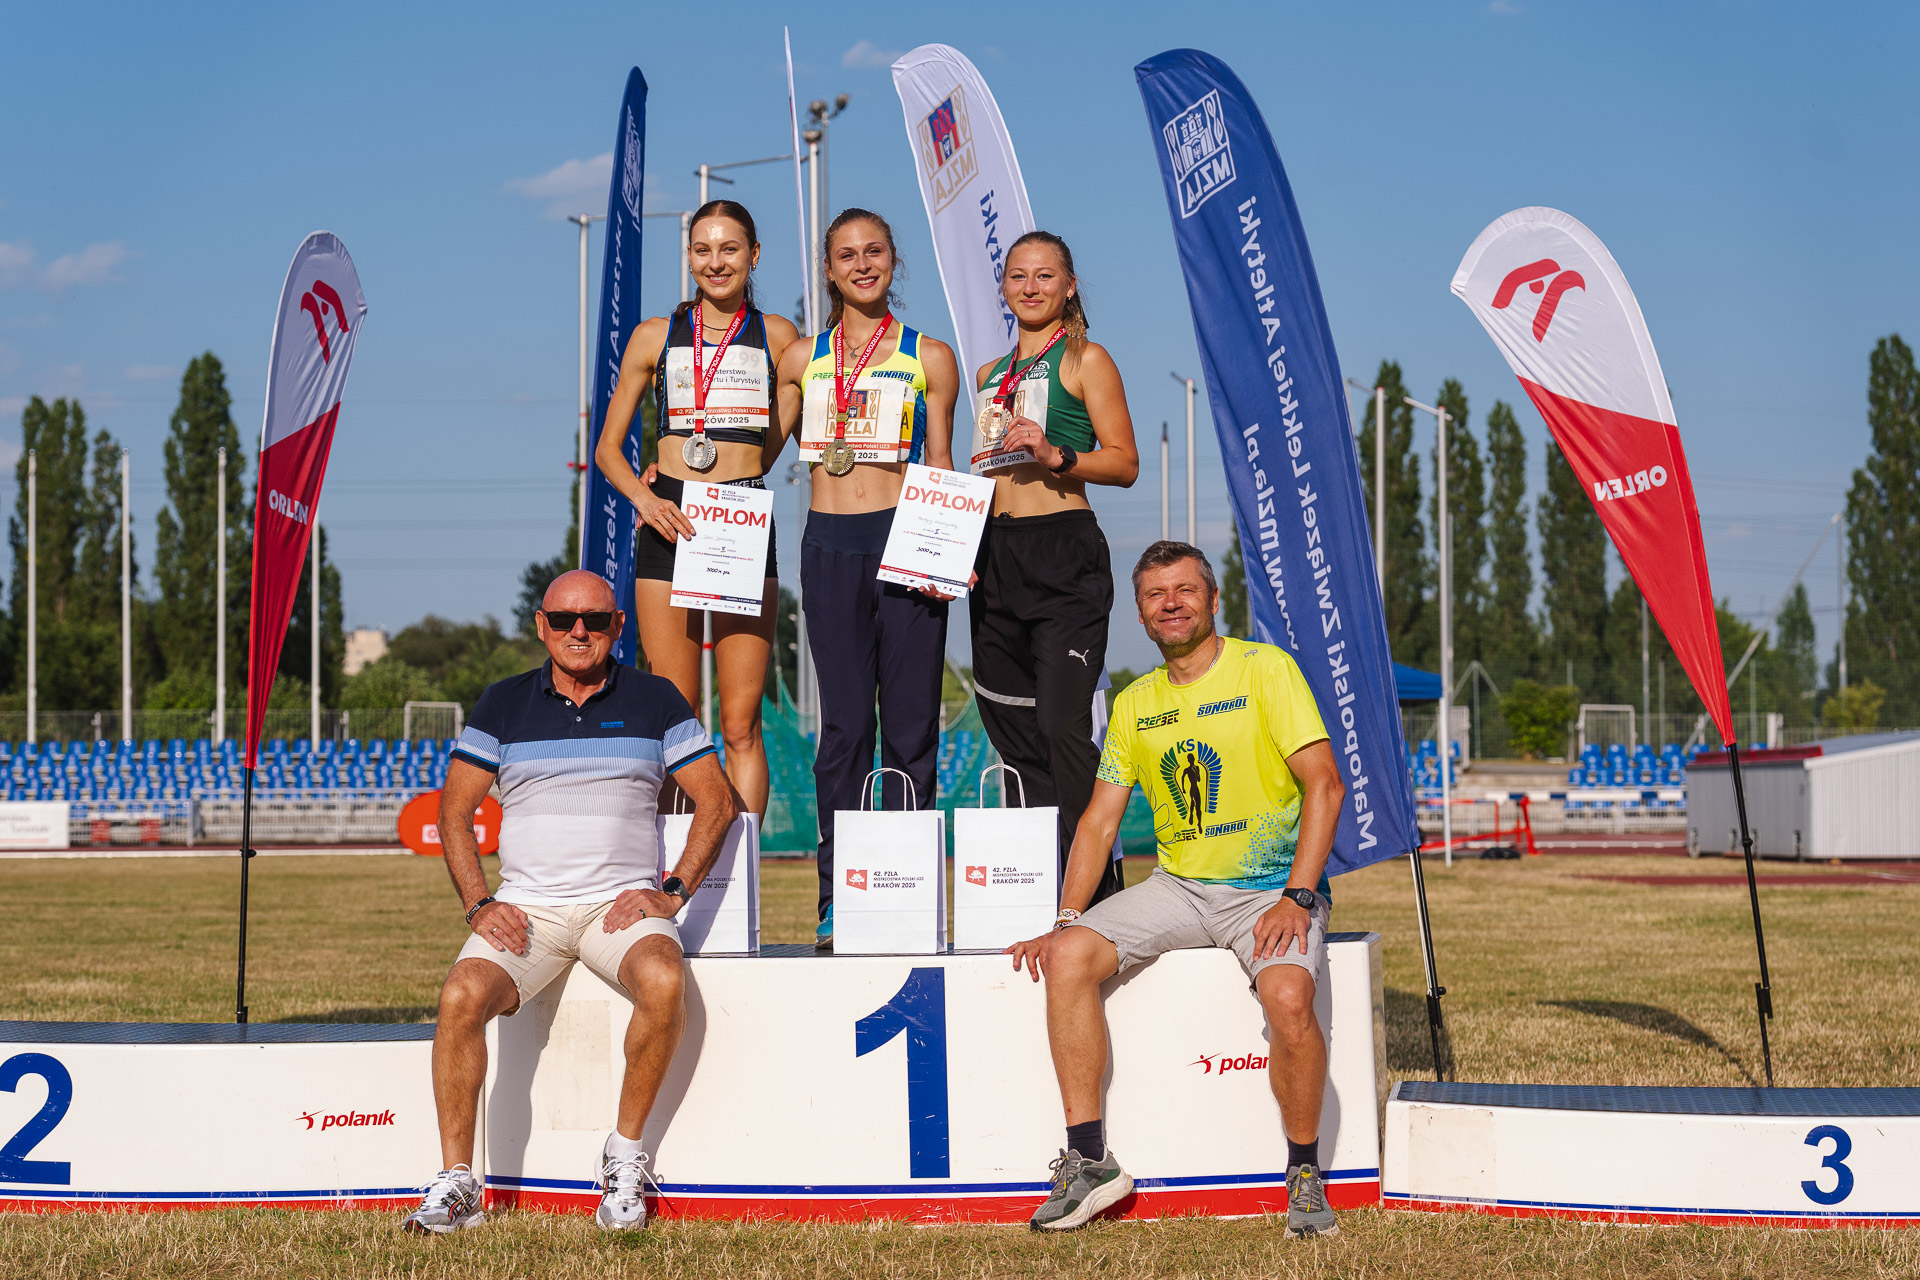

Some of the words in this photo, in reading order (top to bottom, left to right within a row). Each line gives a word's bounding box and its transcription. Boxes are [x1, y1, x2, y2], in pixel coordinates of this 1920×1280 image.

[718, 317, 740, 355] MISTRZOSTWA
[860, 326, 884, 364] MISTRZOSTWA
[708, 356, 720, 377] POLSKI
[849, 364, 862, 384] POLSKI
[871, 370, 916, 383] SONAROL
[730, 376, 760, 384] Turystyki
[979, 457, 1007, 469] KRAKÓW
[1008, 454, 1025, 463] 2025
[269, 489, 308, 525] ORLEN
[905, 485, 986, 514] DYPLOM
[686, 504, 766, 528] DYPLOM
[1197, 696, 1248, 716] SONAROL
[1177, 739, 1196, 754] KS
[1205, 820, 1248, 837] SONAROL
[855, 967, 951, 1178] 1
[1219, 1053, 1269, 1075] polan
[0, 1053, 72, 1185] 2
[321, 1109, 396, 1131] polanik
[1801, 1125, 1854, 1205] 3
